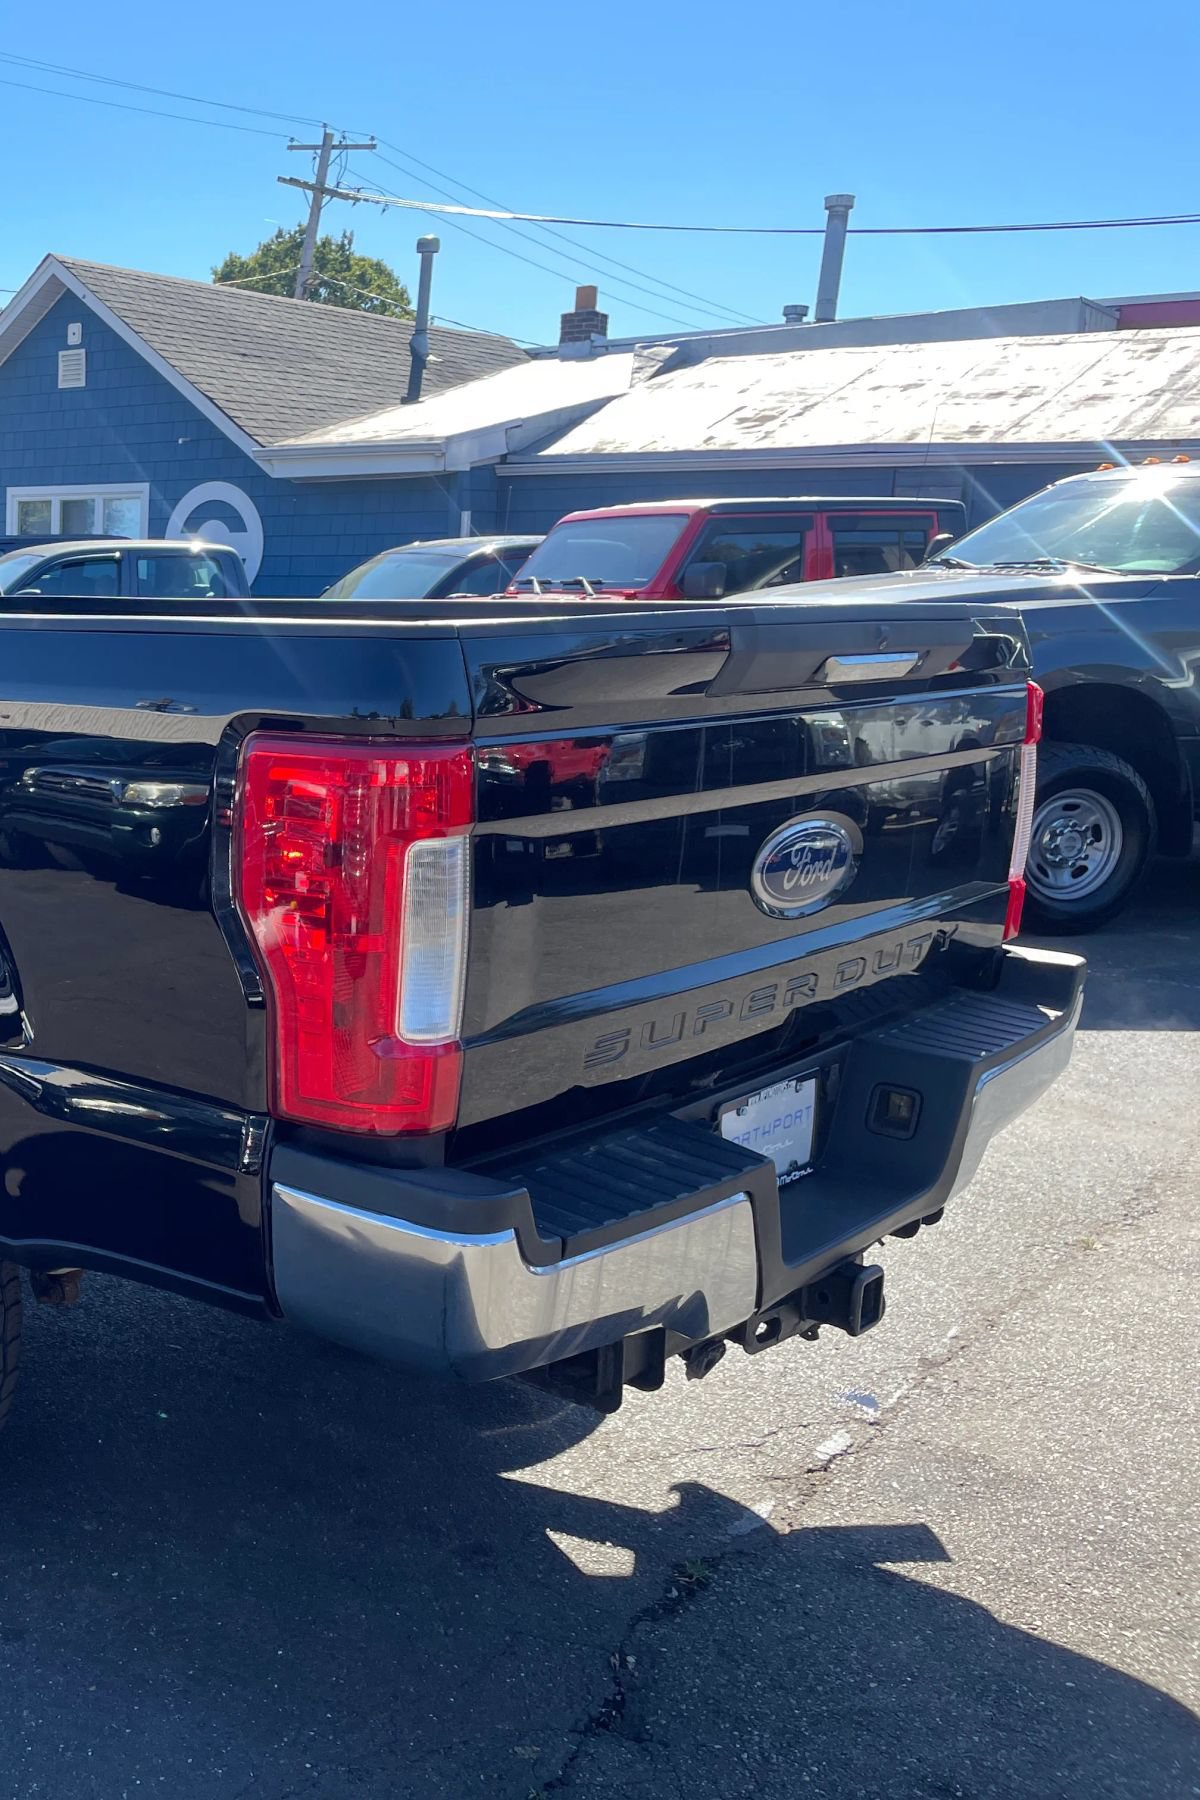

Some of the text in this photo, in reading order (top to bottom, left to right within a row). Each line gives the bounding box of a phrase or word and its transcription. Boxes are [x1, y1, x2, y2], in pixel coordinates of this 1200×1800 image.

[783, 841, 839, 891] Ford
[583, 923, 959, 1071] SUPER DUTY
[730, 1104, 812, 1146] ORTHPORT
